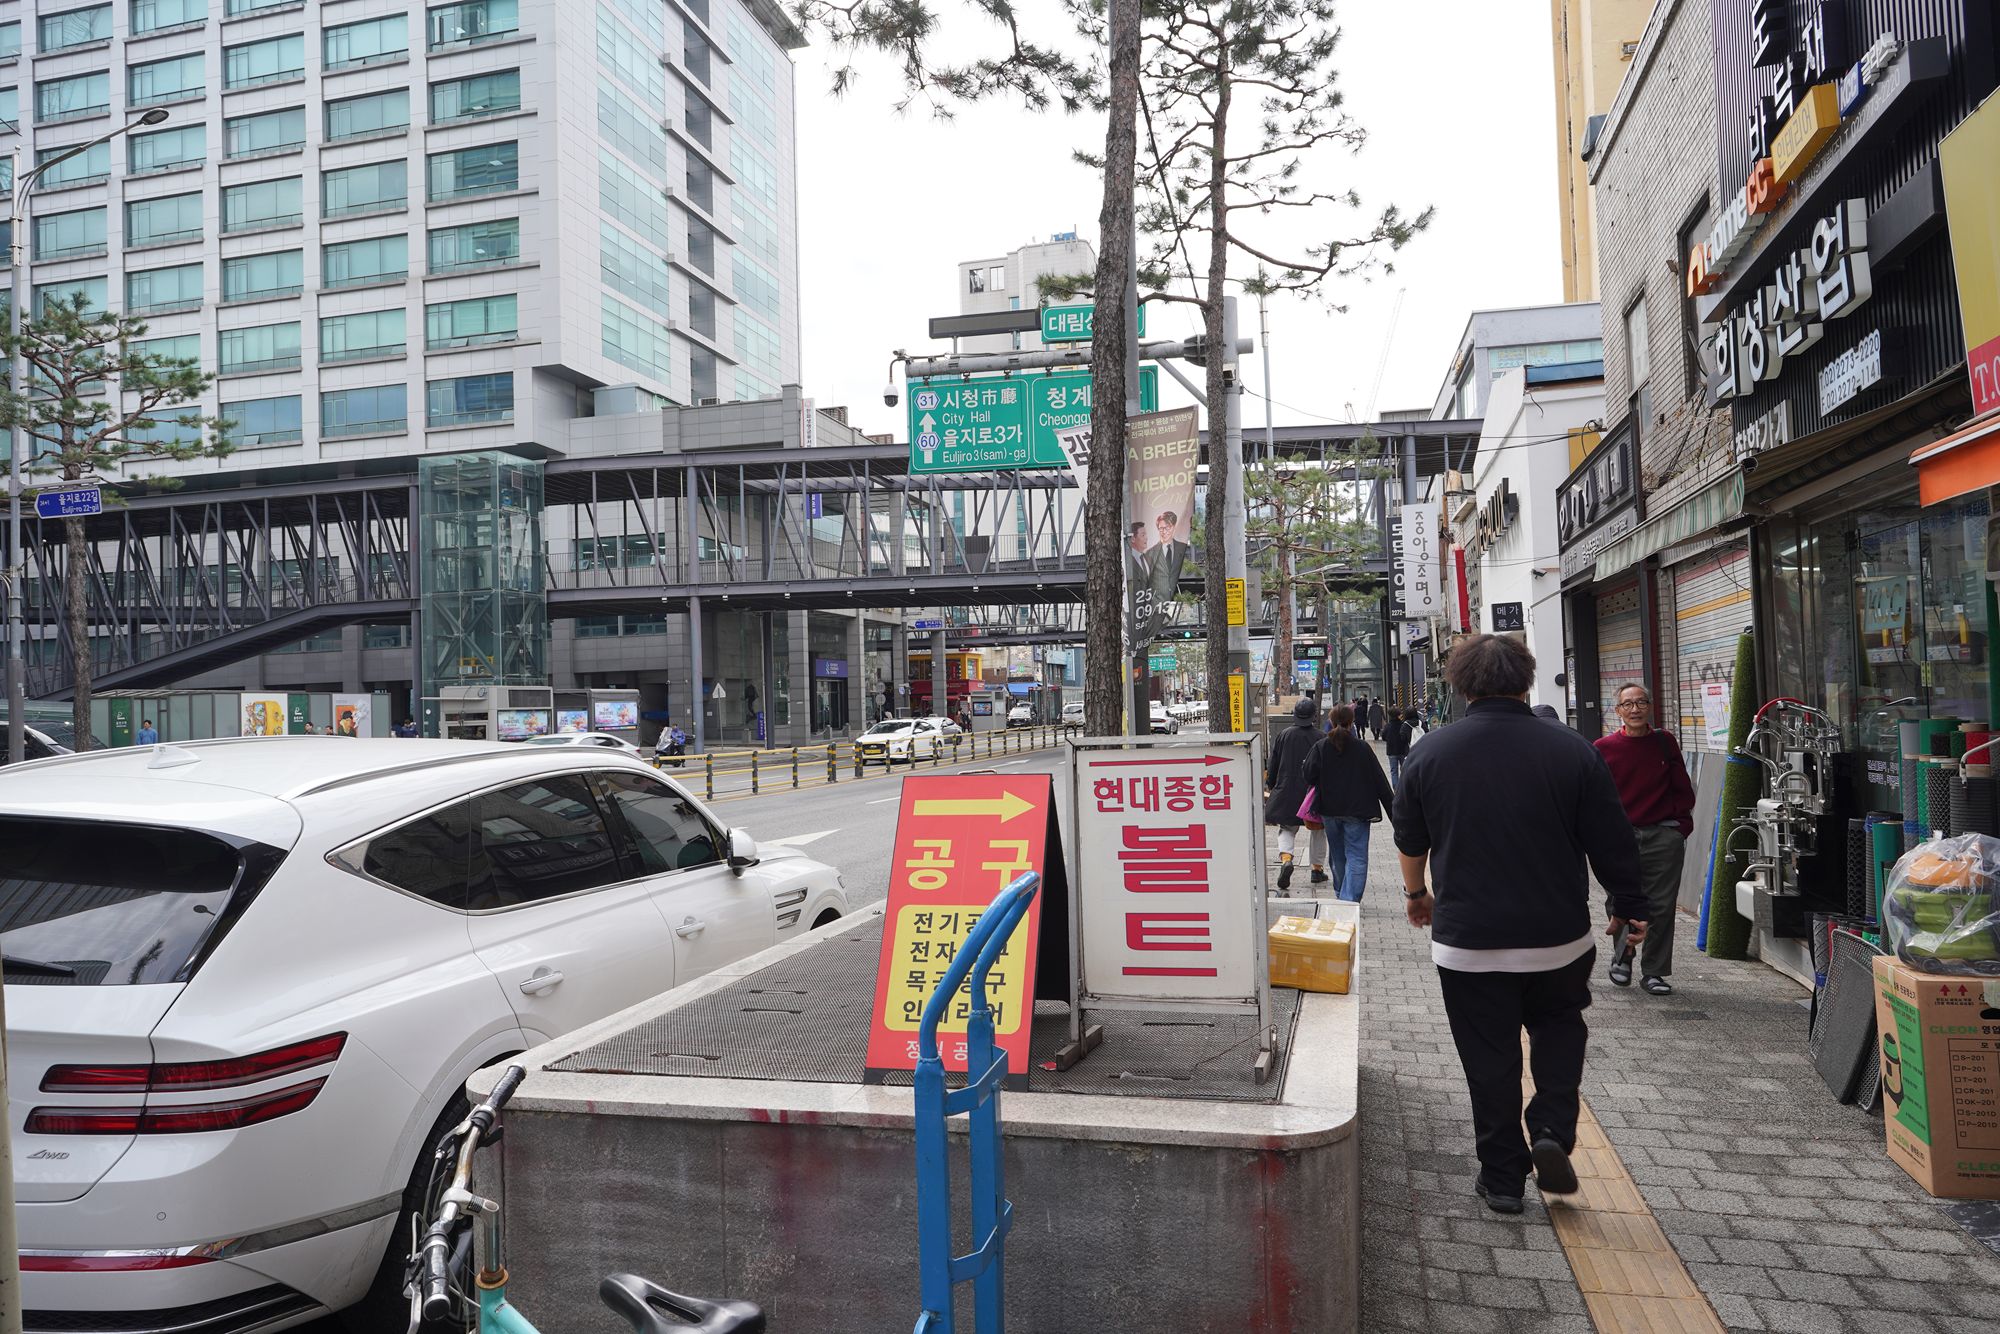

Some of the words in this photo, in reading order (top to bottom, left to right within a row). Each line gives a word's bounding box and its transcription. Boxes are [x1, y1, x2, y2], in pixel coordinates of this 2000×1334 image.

[1748, 3, 1826, 163] 바닥재
[1775, 103, 1813, 170] 인테리어
[1714, 202, 1851, 398] 희성산업
[1048, 311, 1094, 333] 대림
[919, 395, 935, 407] 31
[1046, 384, 1093, 410] 청계
[942, 411, 965, 427] City
[970, 410, 991, 424] Hall
[920, 436, 937, 448] 60
[942, 424, 1024, 448] 을지로3가
[1128, 447, 1139, 461] A
[1183, 453, 1198, 469] of
[58, 491, 98, 506] 을지로22길
[61, 504, 82, 515] Eulji-ro
[1412, 511, 1432, 605] 중앙조명
[1135, 600, 1171, 619] 09/13
[1135, 620, 1149, 630] SAT
[1093, 774, 1234, 813] 현대종합
[1117, 823, 1218, 977] 볼트
[1929, 1025, 1978, 1034] CLEON
